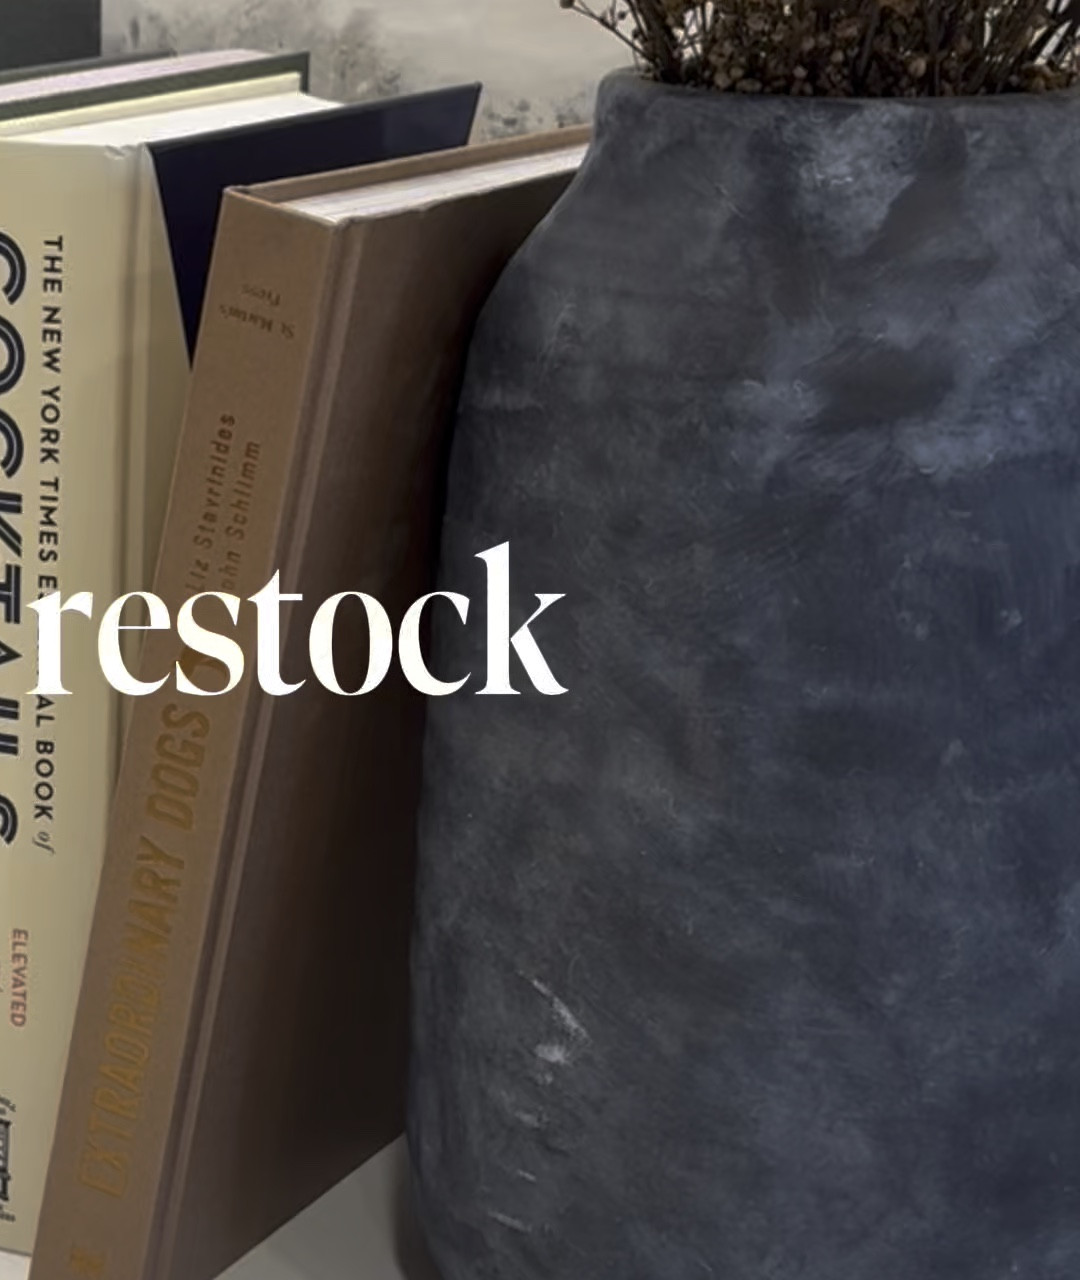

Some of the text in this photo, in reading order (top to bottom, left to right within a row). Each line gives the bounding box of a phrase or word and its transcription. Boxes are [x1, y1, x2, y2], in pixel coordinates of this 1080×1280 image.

[42, 234, 64, 294] THE
[41, 305, 62, 374] NEW
[39, 385, 61, 465] YORK
[37, 476, 60, 563] TIMES
[219, 549, 242, 592] ohn
[34, 739, 56, 821] BOOK
[32, 830, 56, 855] of
[10, 927, 29, 1028] ELEVATED
[76, 702, 211, 1200] EXTRAORDINARY DOGS
